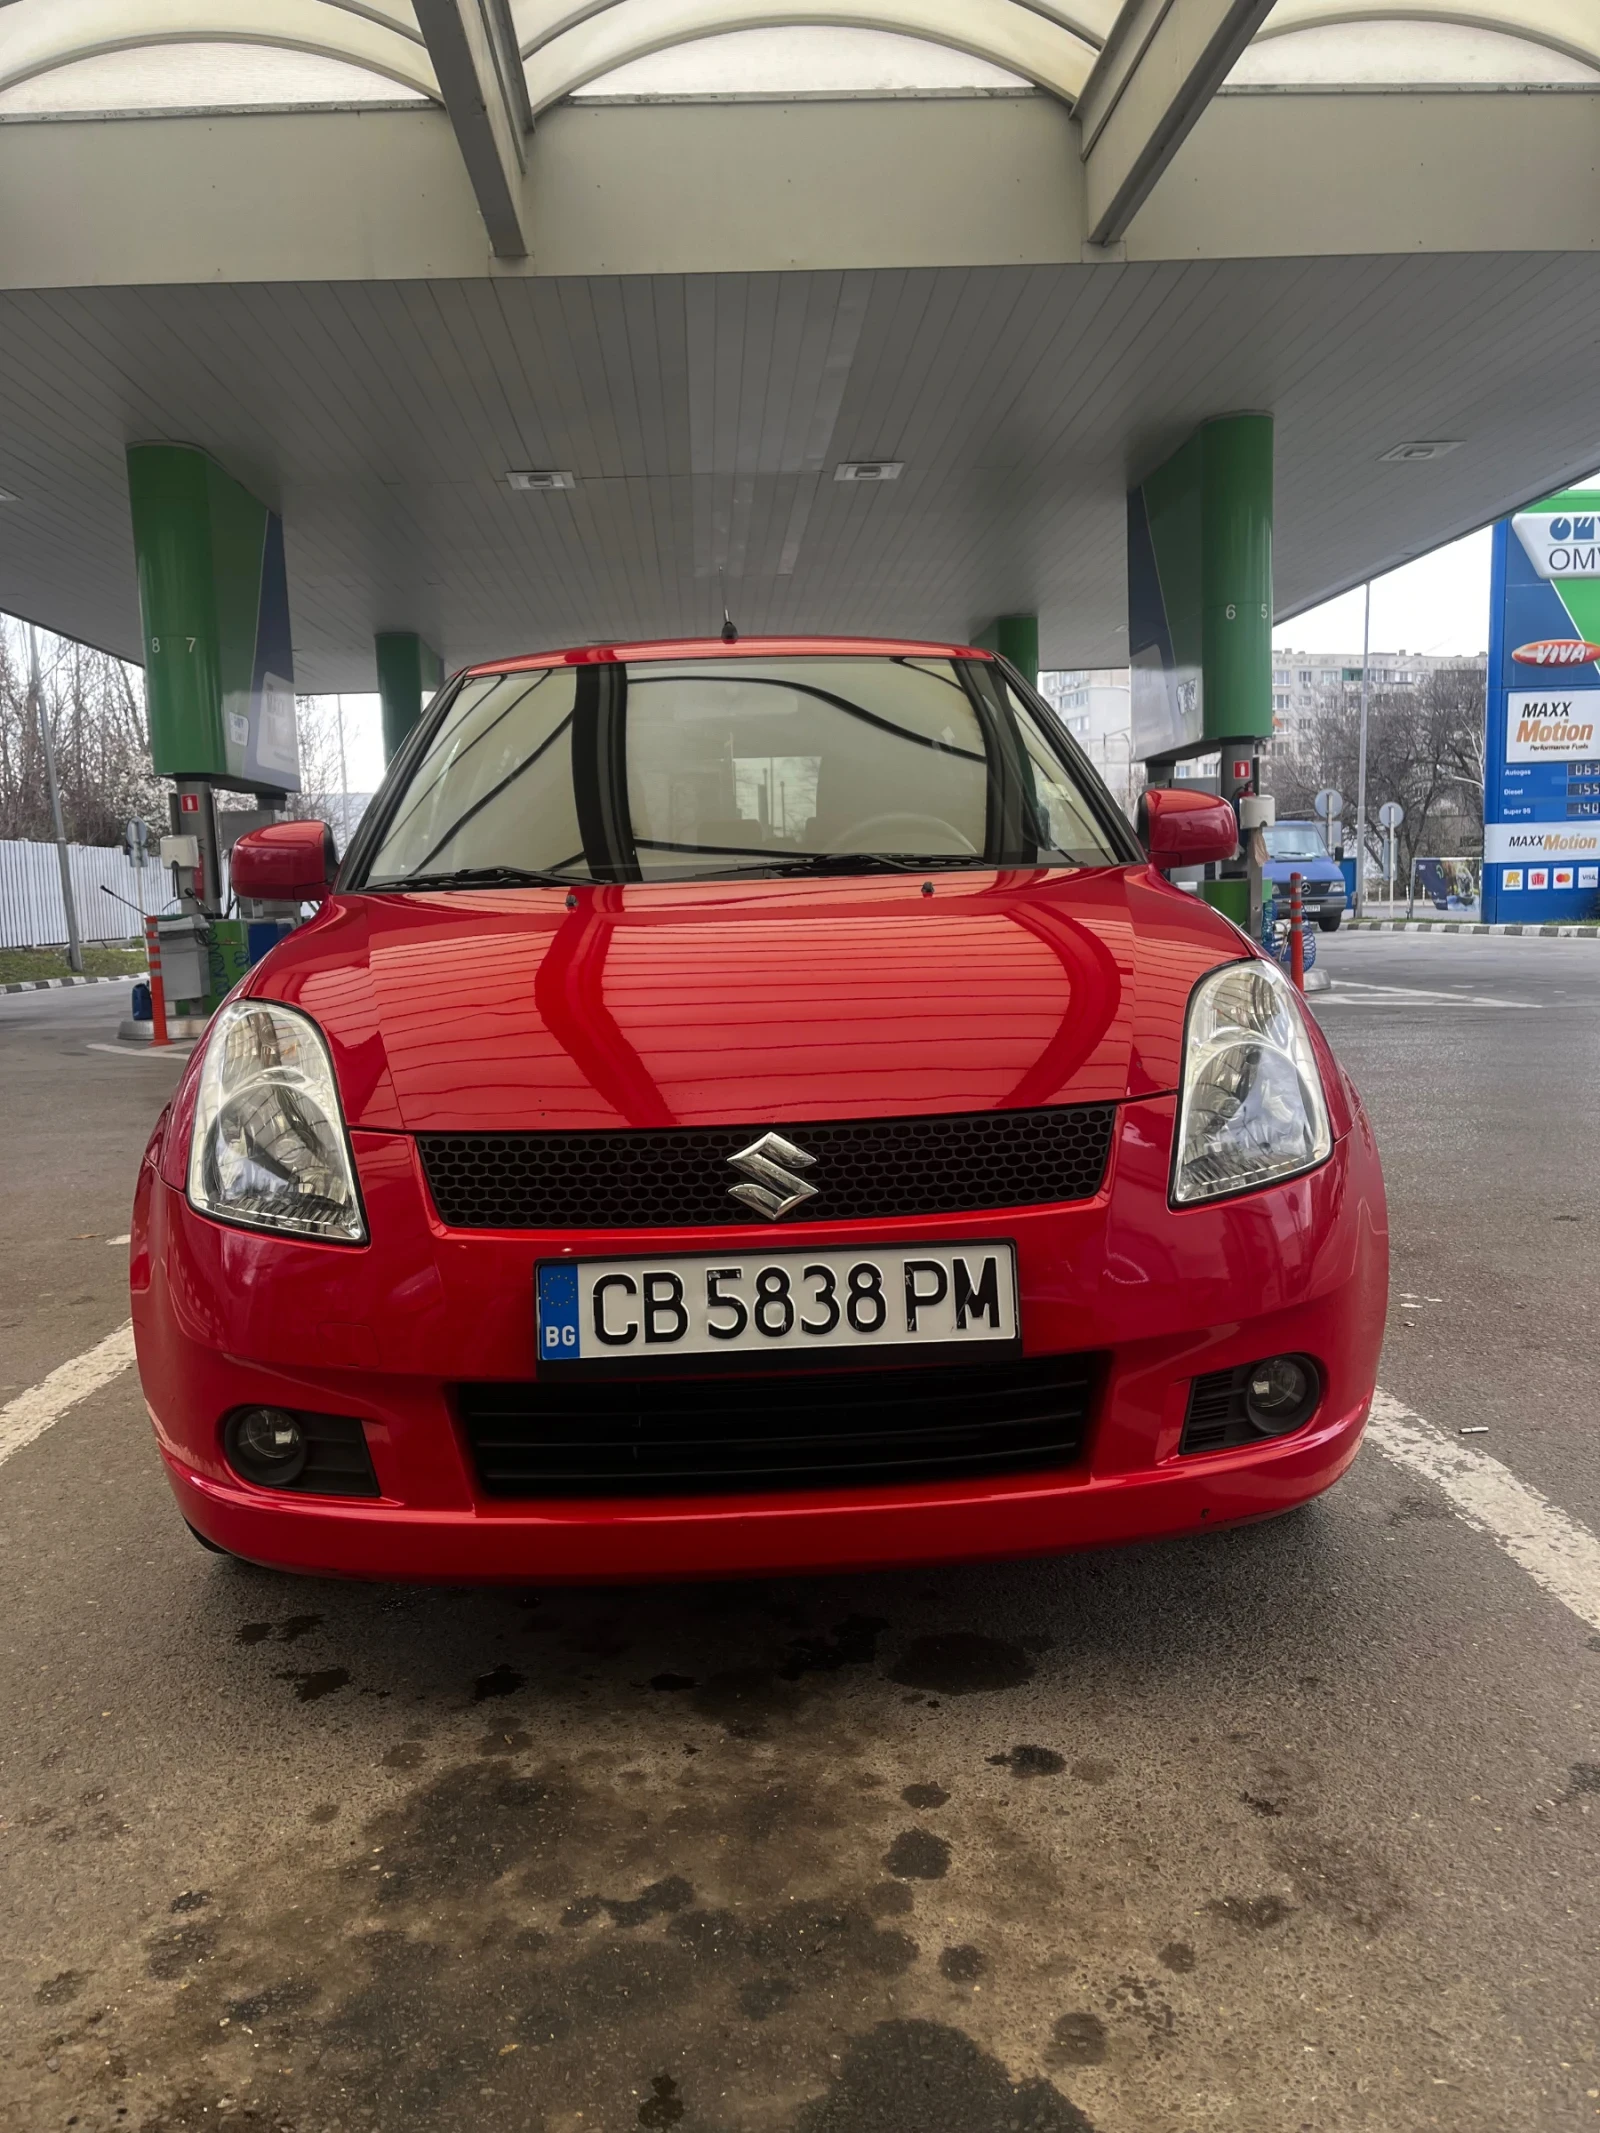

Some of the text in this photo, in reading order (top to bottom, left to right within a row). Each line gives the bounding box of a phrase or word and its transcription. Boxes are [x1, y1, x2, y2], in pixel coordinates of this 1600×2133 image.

[1549, 547, 1600, 571] OM
[1226, 603, 1268, 619] 6 5
[152, 637, 196, 653] 8 7
[1536, 644, 1586, 664] VIVA
[1522, 702, 1572, 718] MAXX
[1516, 719, 1594, 742] Motion
[1509, 833, 1597, 851] MAXX Motion
[592, 1257, 1000, 1347] CB 5838 PM
[544, 1325, 576, 1347] BG
